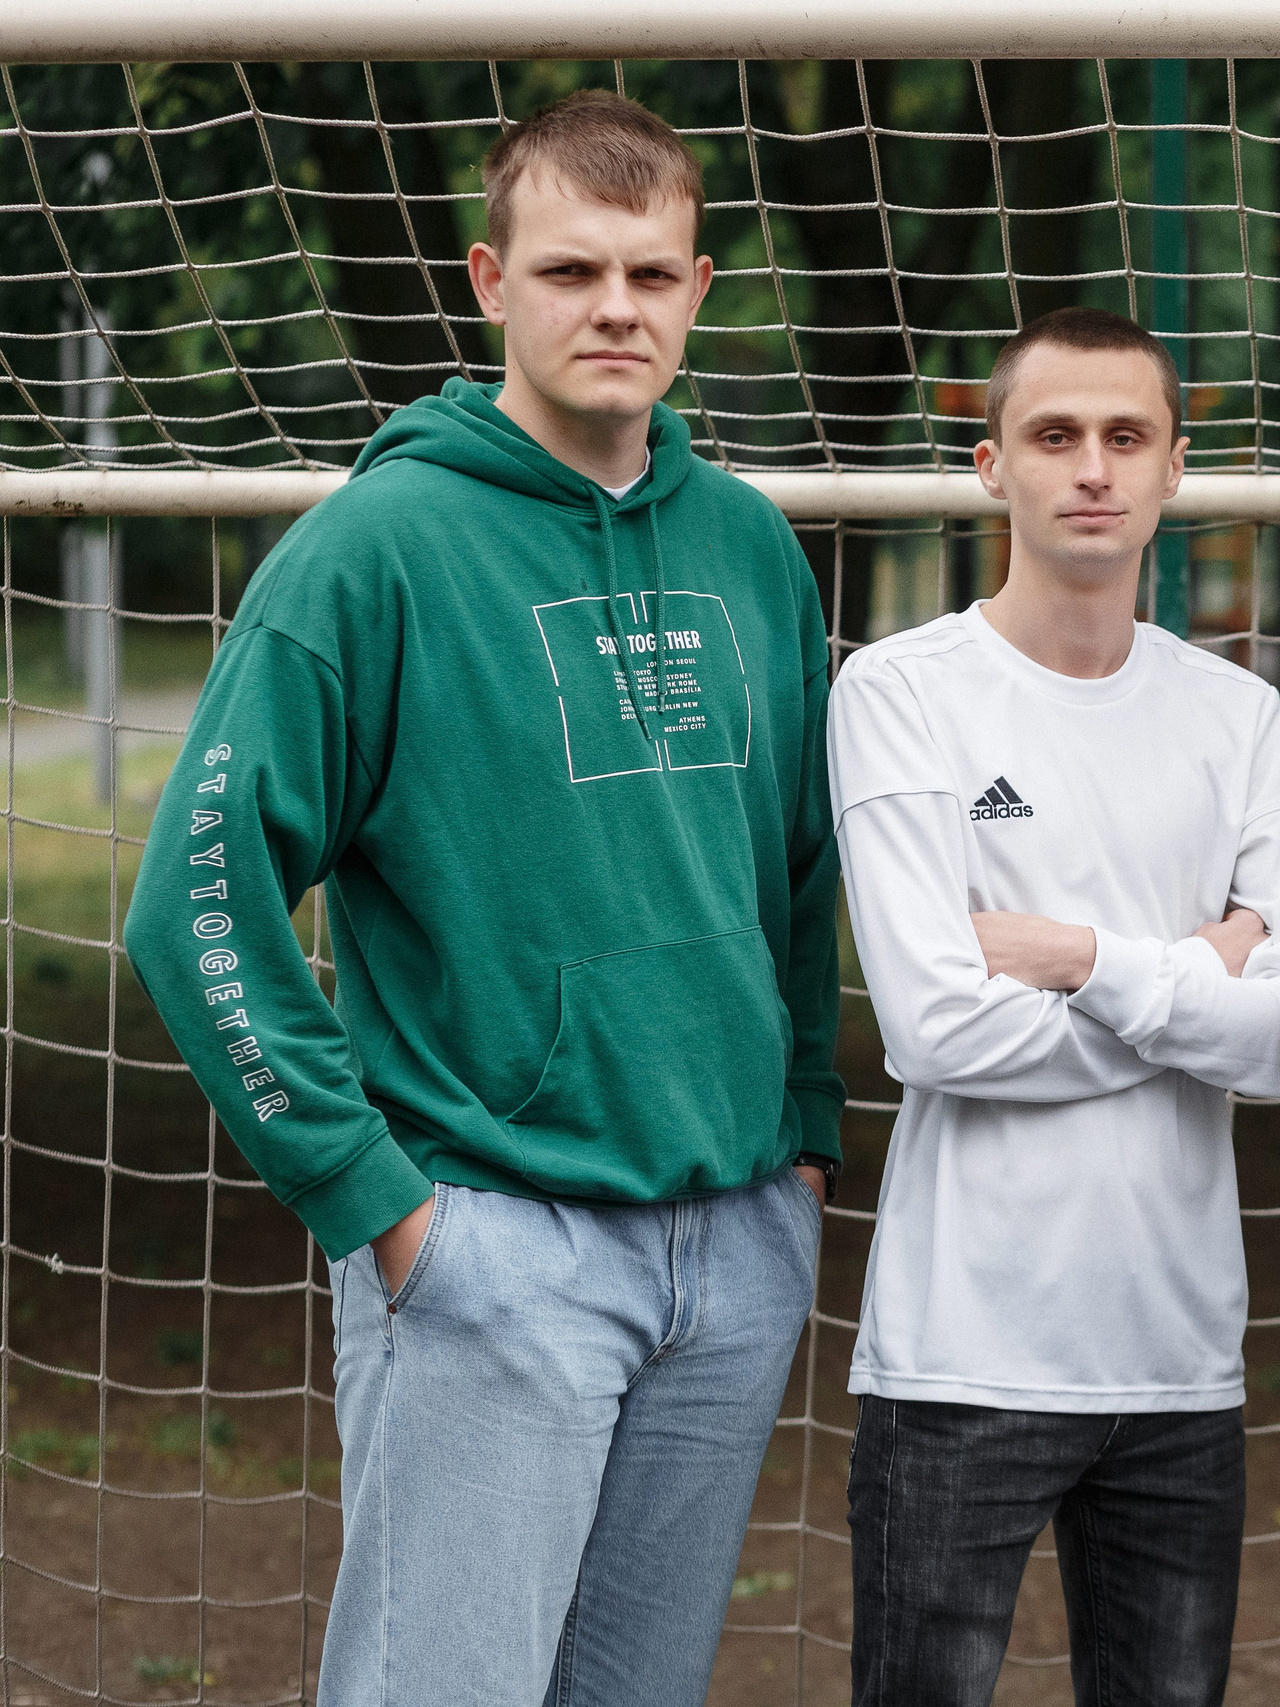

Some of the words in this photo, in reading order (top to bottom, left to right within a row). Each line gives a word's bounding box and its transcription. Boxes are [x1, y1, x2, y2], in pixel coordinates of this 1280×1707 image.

[626, 630, 702, 654] TOGTHER
[666, 672, 693, 680] SYDNEY
[670, 686, 702, 695] BRASÍLIA
[679, 715, 706, 724] ATHENS
[664, 724, 688, 733] MEXICO
[969, 804, 1034, 821] adidas
